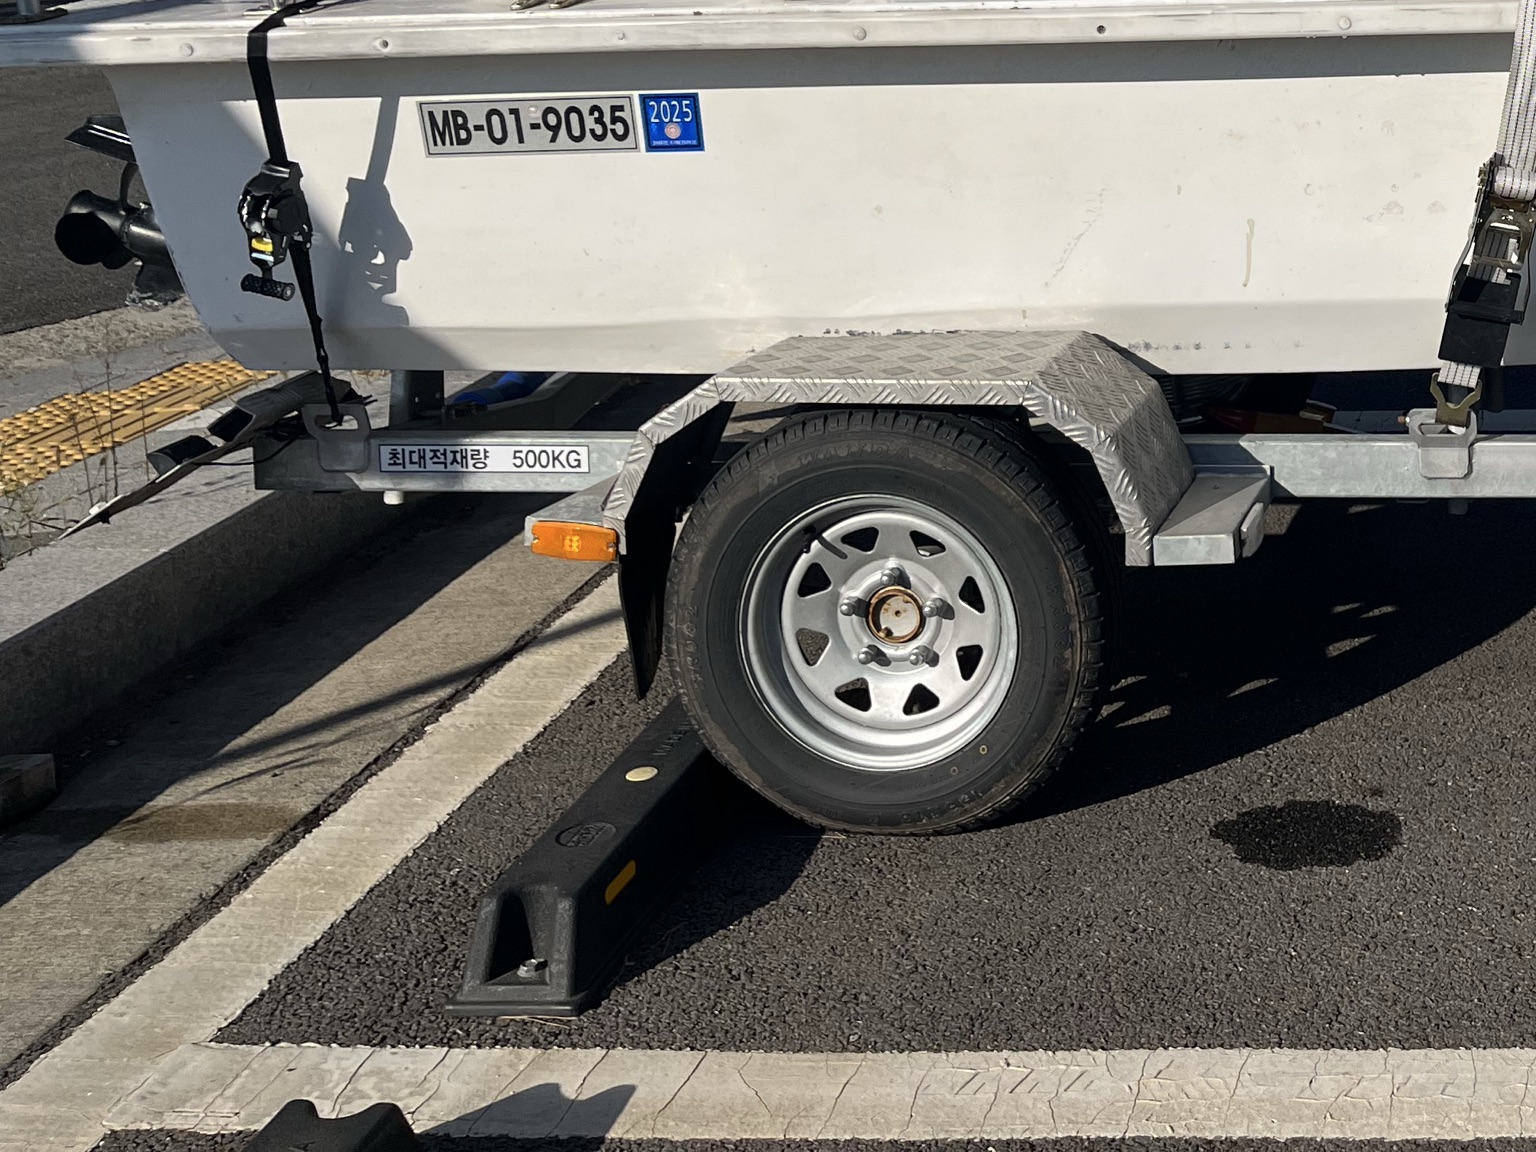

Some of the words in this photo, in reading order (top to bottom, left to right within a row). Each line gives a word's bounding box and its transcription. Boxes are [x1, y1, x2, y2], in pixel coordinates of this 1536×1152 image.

[649, 100, 693, 123] 2025
[427, 103, 631, 147] MB-01-9035
[387, 447, 490, 470] 최대적재량
[511, 448, 583, 470] 500KG
